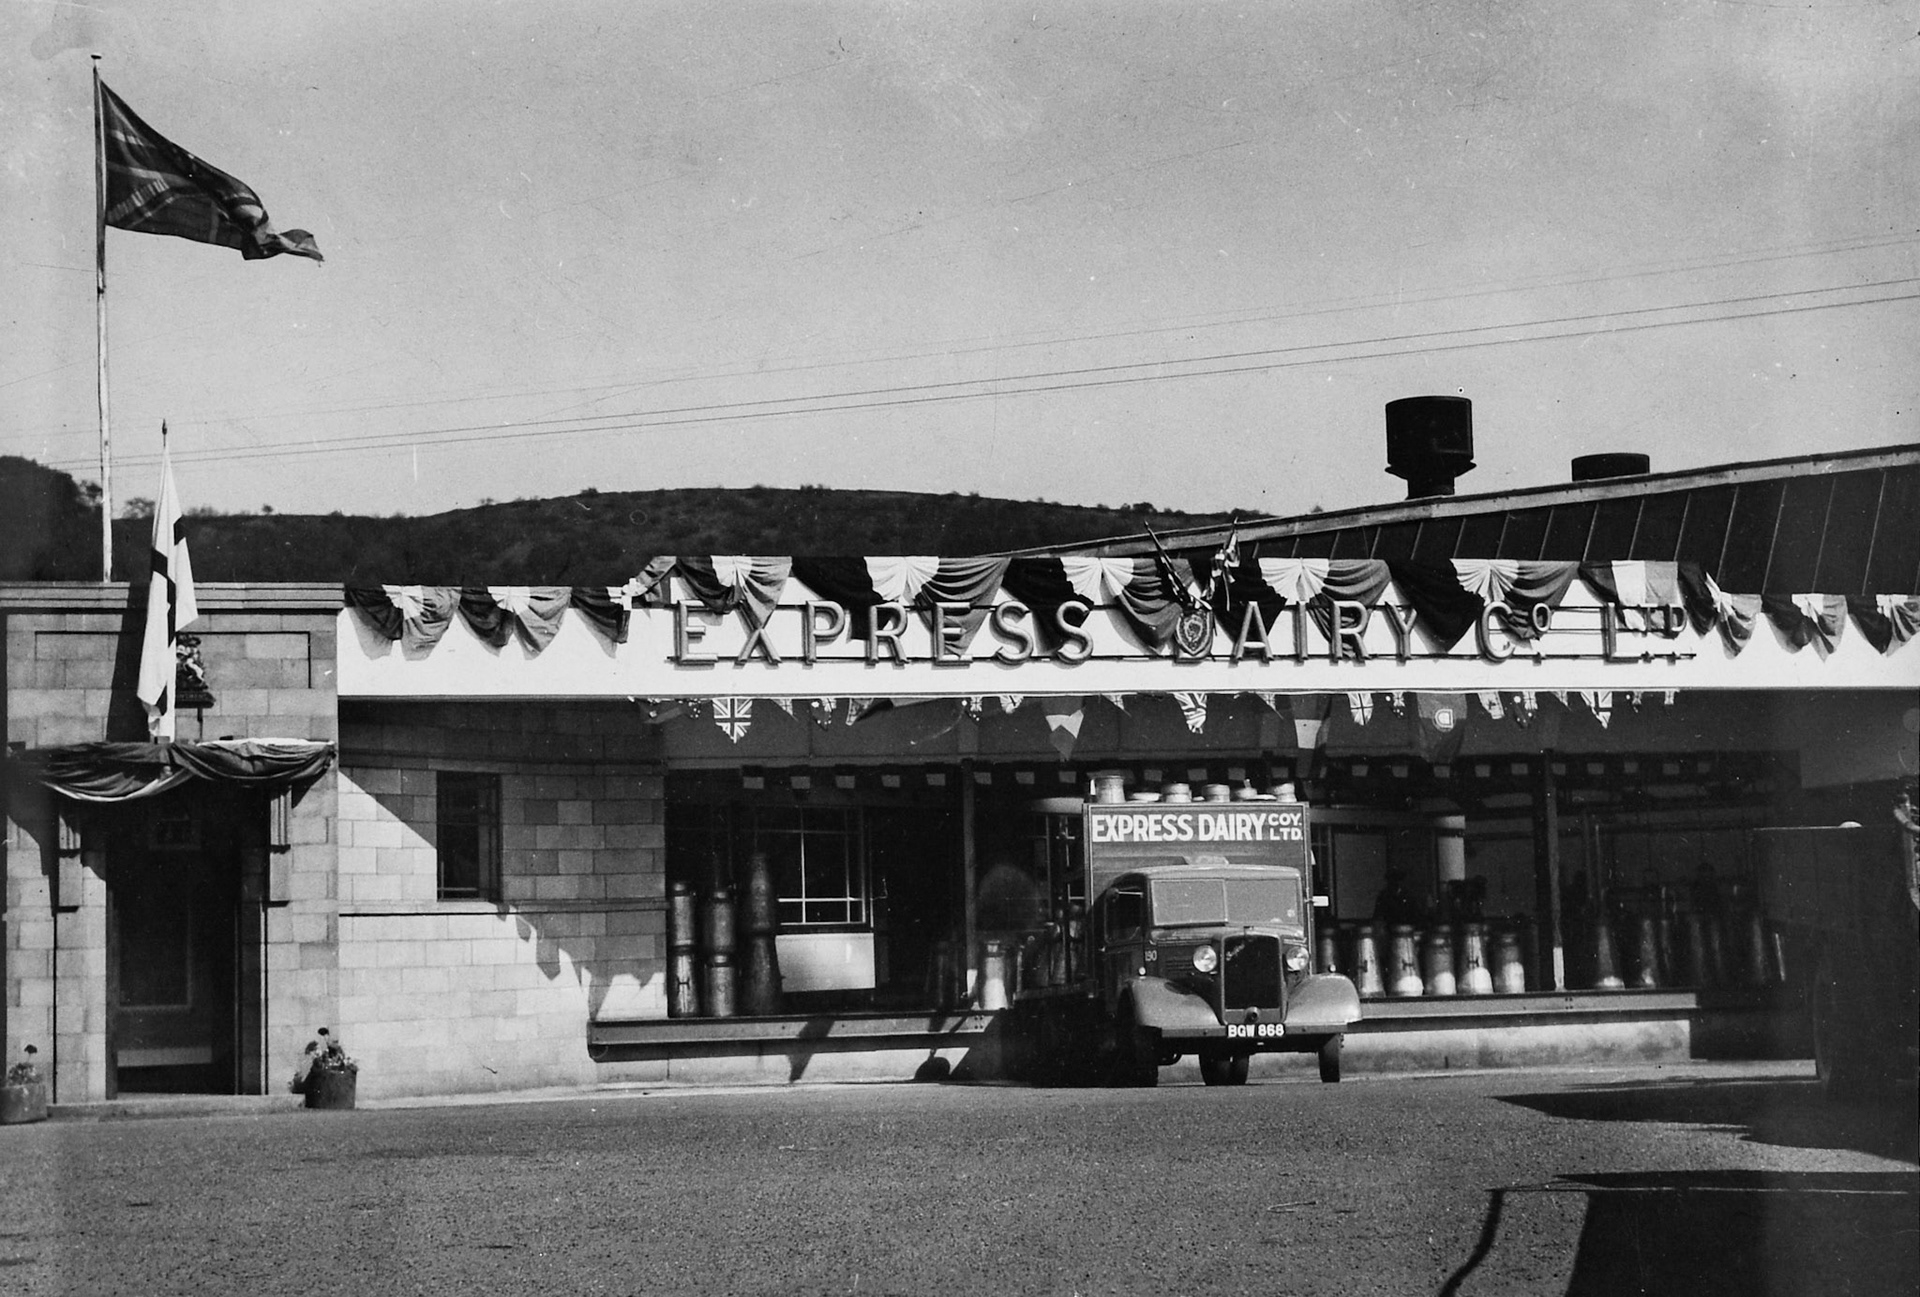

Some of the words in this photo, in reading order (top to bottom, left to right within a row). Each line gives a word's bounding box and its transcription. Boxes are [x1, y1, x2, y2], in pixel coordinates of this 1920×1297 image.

[674, 600, 1094, 665] EXPRESS
[1091, 814, 1194, 842] EXPRESS
[1198, 813, 1266, 841] DAIRY
[1227, 1024, 1255, 1038] BGW
[1258, 1023, 1285, 1037] 868
